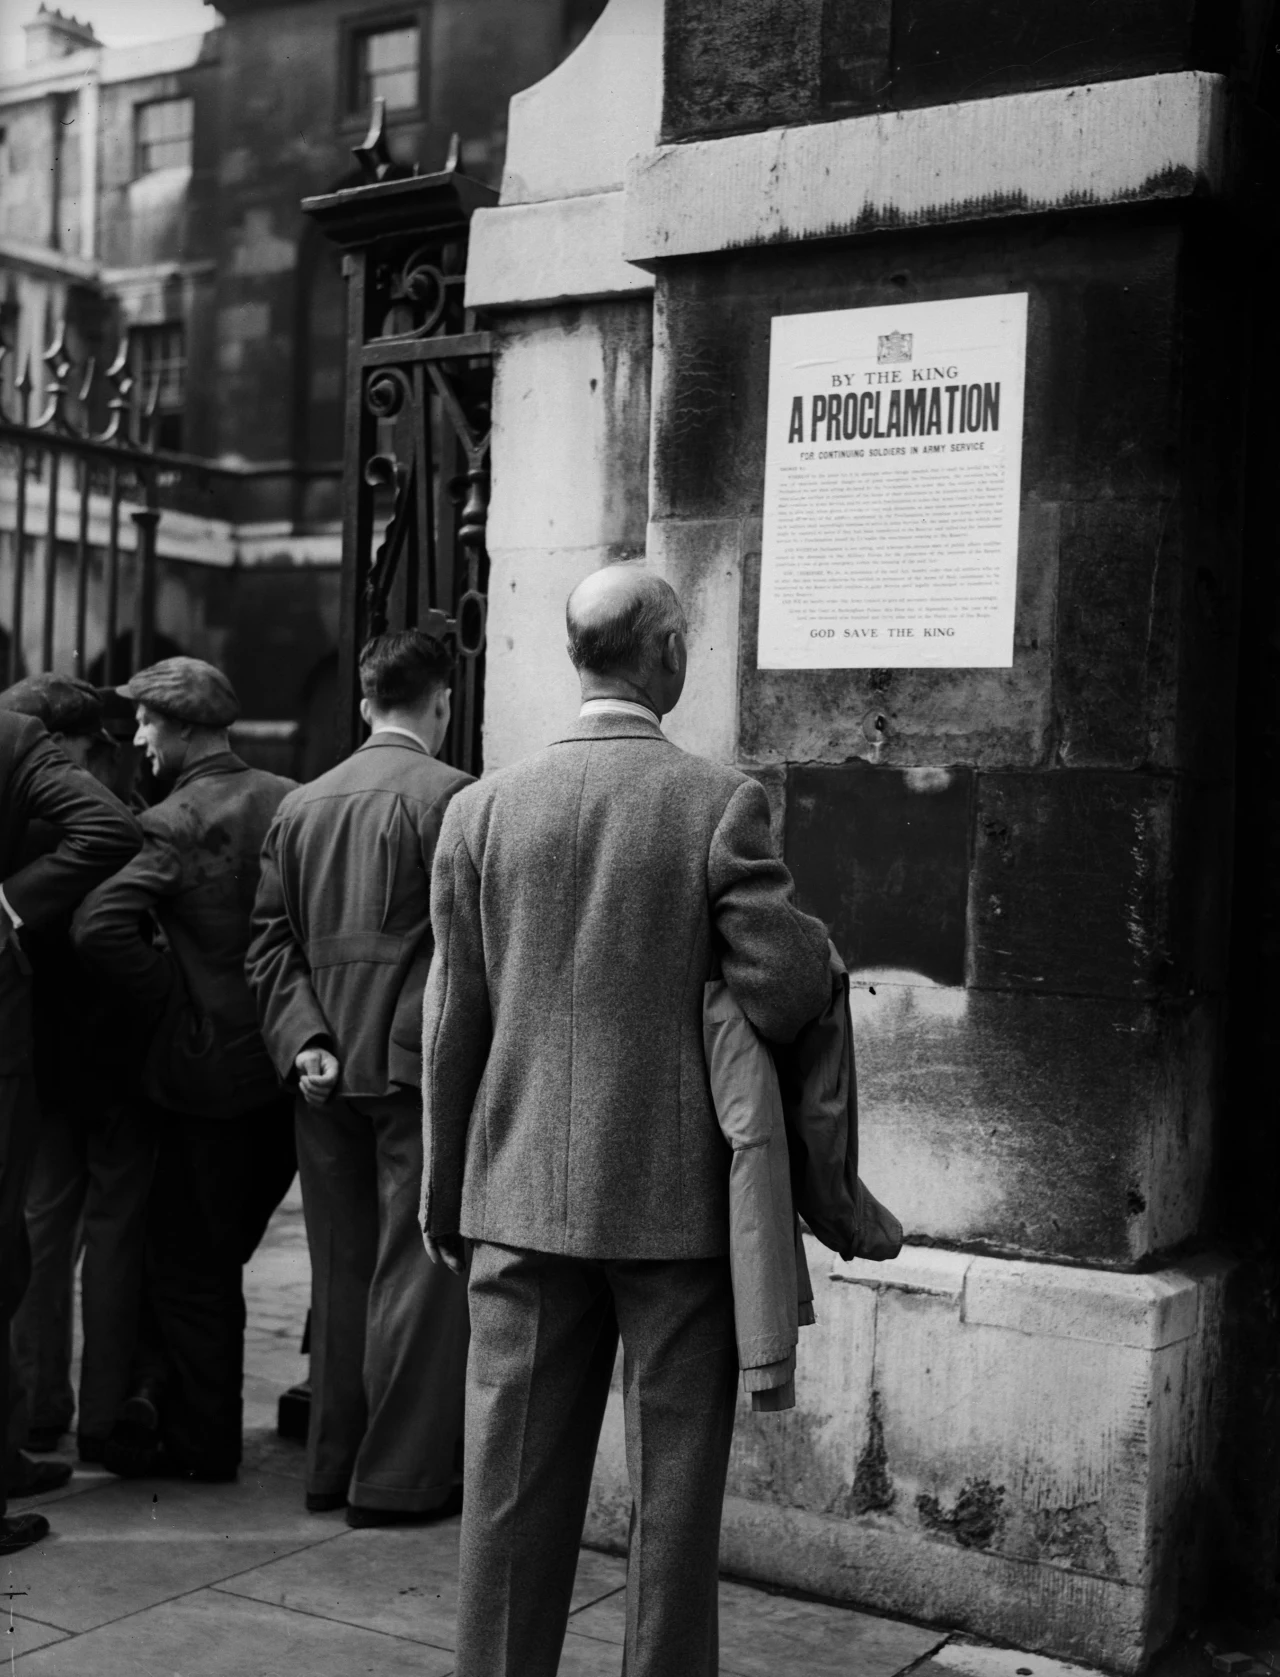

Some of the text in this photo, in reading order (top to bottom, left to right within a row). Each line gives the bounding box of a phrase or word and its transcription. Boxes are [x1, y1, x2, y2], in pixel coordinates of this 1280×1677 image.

[831, 366, 958, 387] BY THE KING
[788, 381, 1001, 443] A PROCLAMATION
[800, 442, 985, 461] FOR CONTINUING SOLDIERS IN ARMY SERVICE
[810, 627, 955, 639] GOD SAVE THE KING
